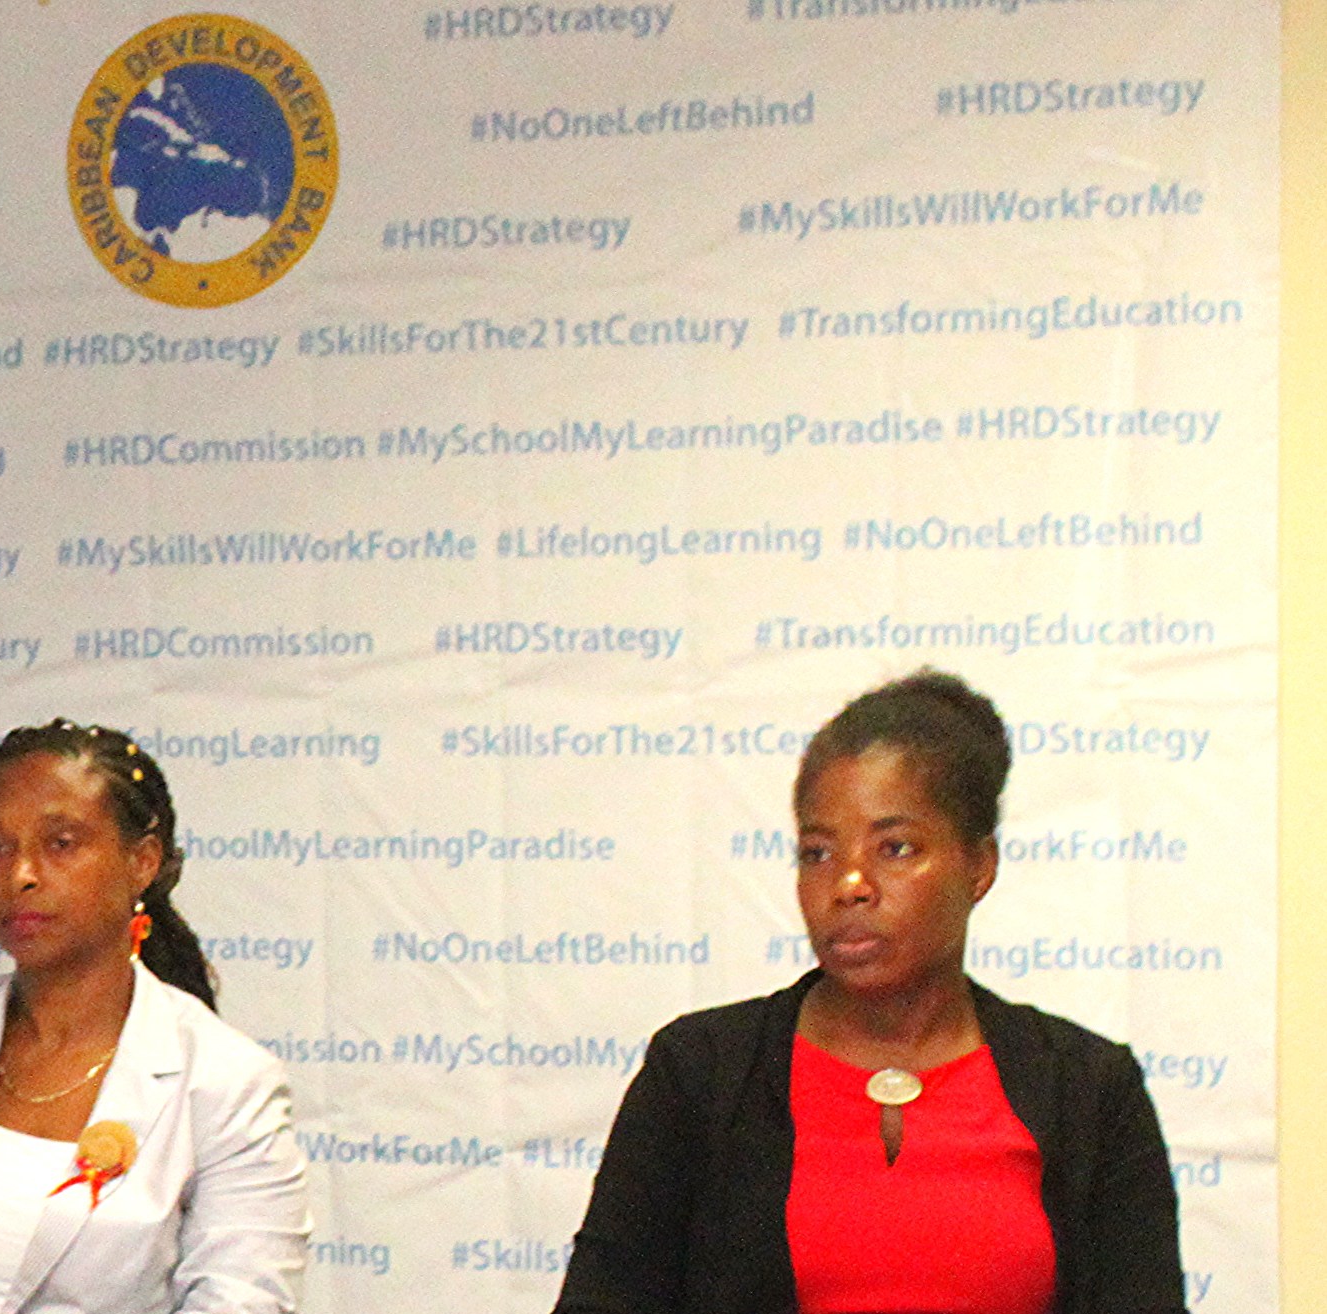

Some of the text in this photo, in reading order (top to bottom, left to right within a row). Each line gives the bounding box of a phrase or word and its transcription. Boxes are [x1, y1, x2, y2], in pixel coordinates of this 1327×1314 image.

[424, 1, 673, 40] #HRDStrategy
[470, 78, 1206, 142] #NoOneLeftBehind #HRDStrategy
[75, 27, 330, 284] CARIBBEAN DEVELOPMENT BANK
[382, 179, 1205, 250] #HRDStrategy #MySkillsWillWorkForMe
[43, 331, 280, 369] #HRDStrategy
[297, 311, 750, 358] #SkillsForThe21stCentury
[778, 291, 1243, 340] #TransformingEducation
[63, 429, 367, 466] #HRDCommission
[376, 409, 944, 463] #MySchoolMyLearningParadise
[956, 404, 1222, 444] #HRDStrategy
[57, 528, 477, 573] #MySkillsWillWorkForMe
[496, 521, 823, 565] #LifelongLearning
[844, 512, 1203, 551] #NoOneLeftBehind
[74, 626, 374, 661] #HRDCommission
[434, 621, 684, 660] #HRDStrategy
[755, 613, 1215, 655] #TransformingEducation
[127, 725, 380, 765] elongLearning
[442, 723, 815, 757] #SkillsForThe21stCe
[1007, 720, 1210, 760] DStrategy
[181, 829, 616, 867] hoolMyLearningParadise
[373, 931, 710, 966] #NoOneLeftBehind
